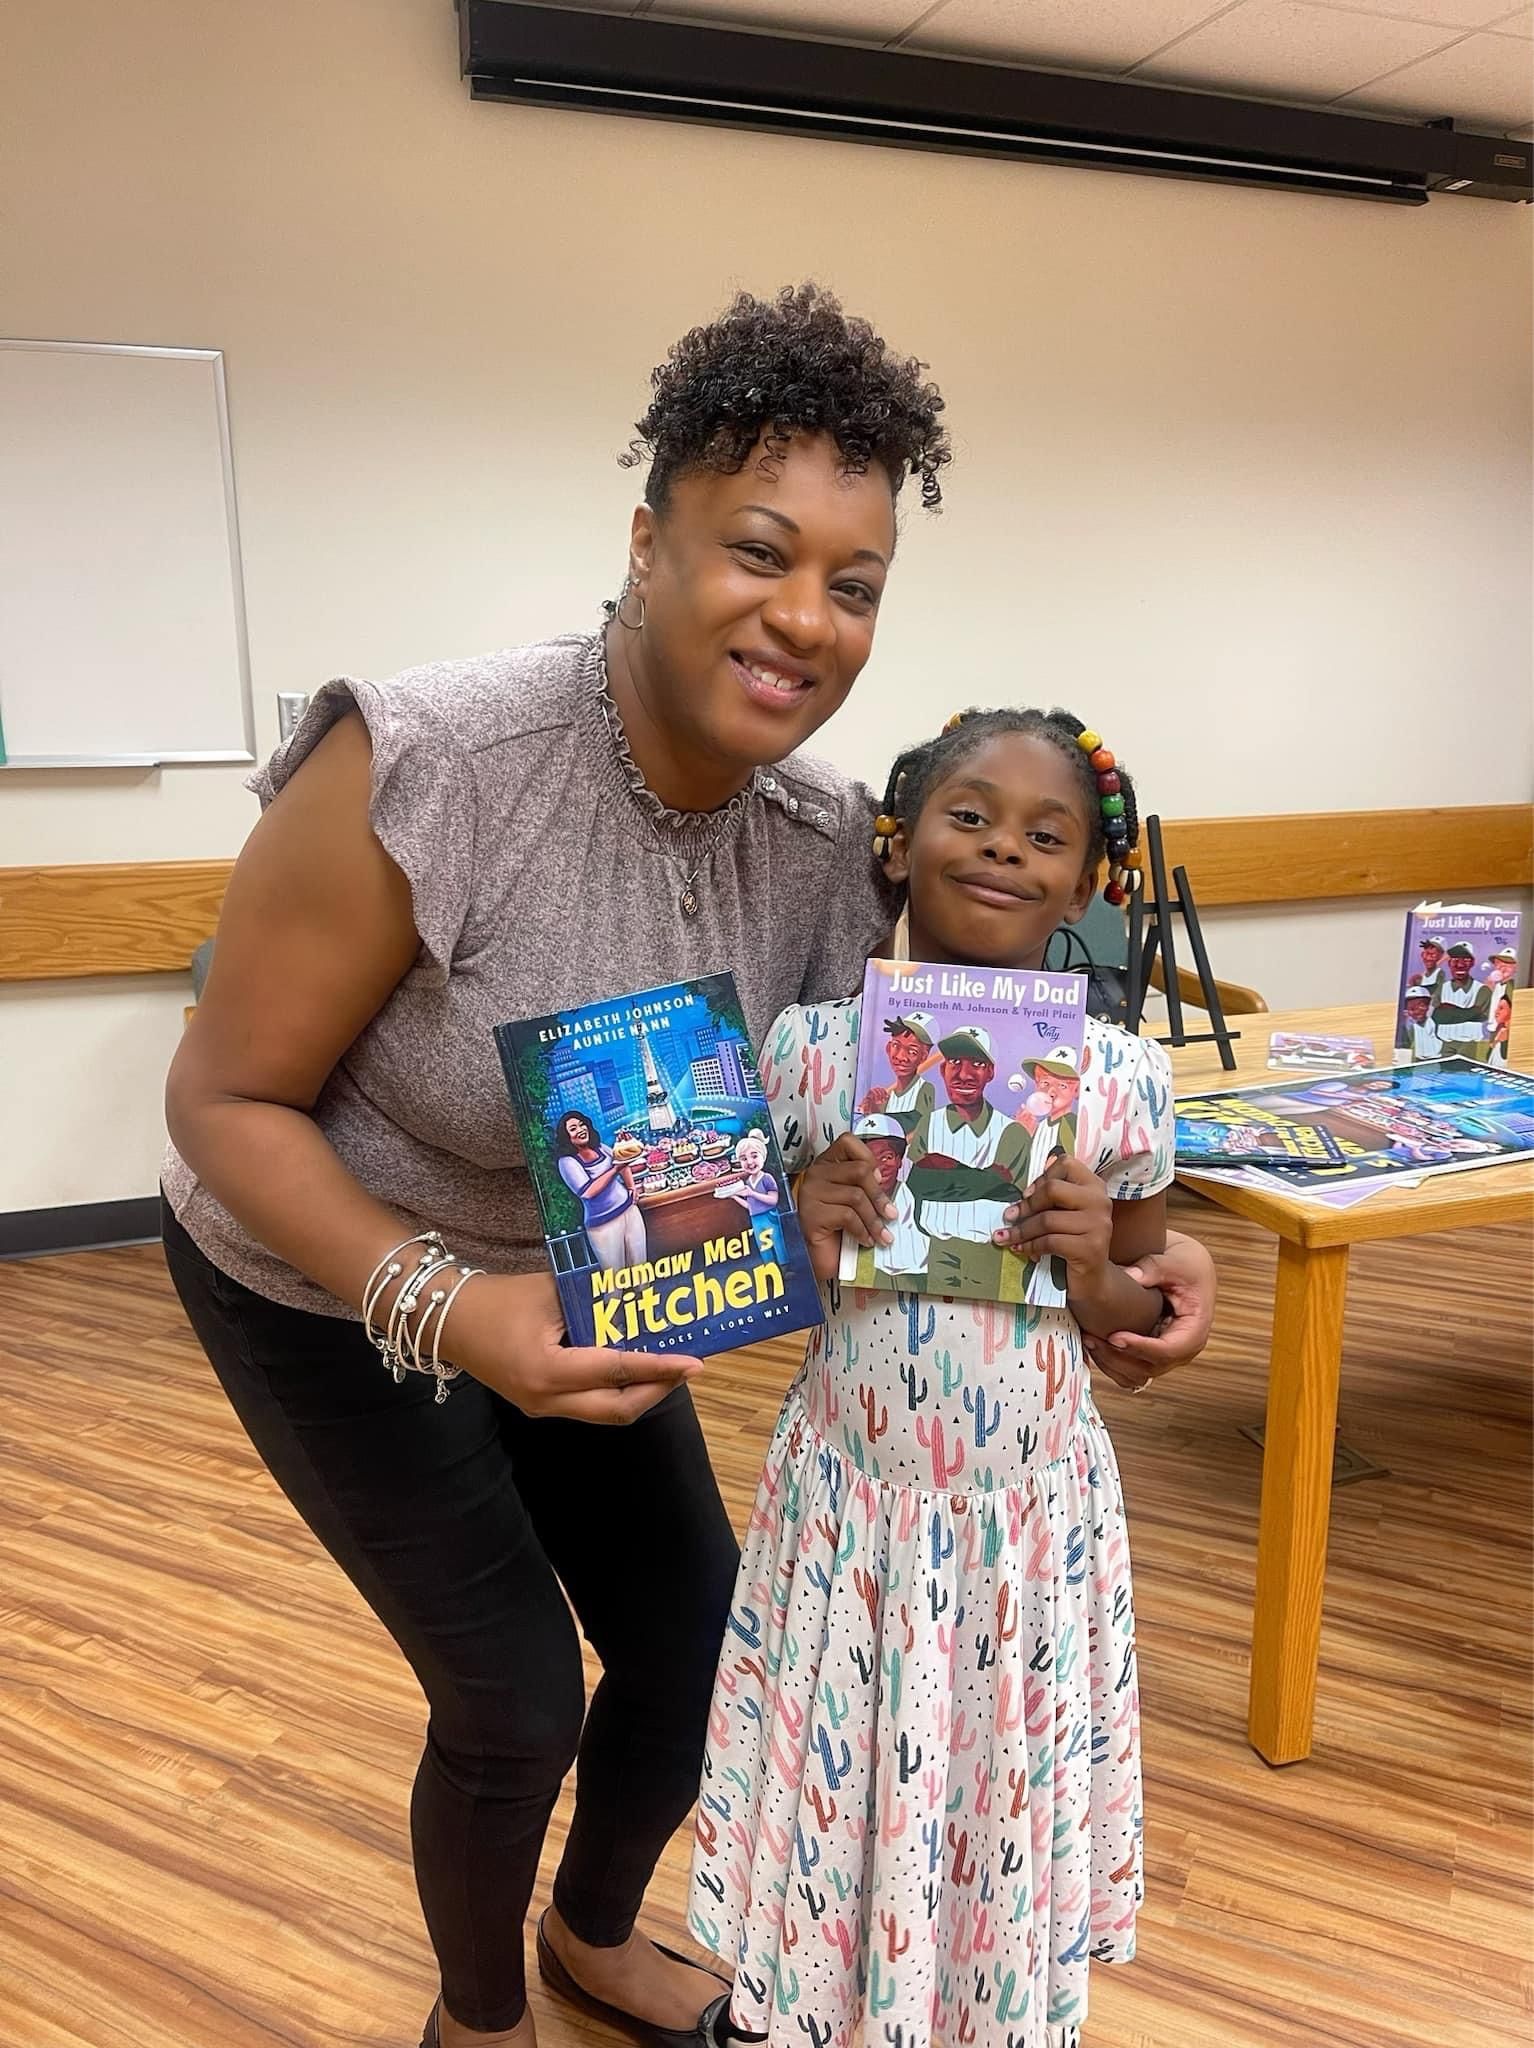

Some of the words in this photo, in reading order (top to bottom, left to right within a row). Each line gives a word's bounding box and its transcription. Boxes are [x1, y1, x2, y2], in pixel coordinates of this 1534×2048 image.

[1422, 916, 1446, 929] Just
[1448, 916, 1471, 929] Like
[1474, 916, 1491, 930] My
[1494, 916, 1518, 929] Dad
[888, 997, 901, 1007] By
[903, 999, 949, 1011] Elizabeth
[967, 1004, 1008, 1015] Johnson
[1012, 1007, 1020, 1016] &
[889, 969, 934, 995] Just
[941, 974, 985, 999] Like
[992, 976, 1027, 1007] My
[1033, 979, 1080, 1006] Dad
[539, 1011, 620, 1042] ELIZABETH
[626, 994, 694, 1021] JOHNSON
[573, 1027, 626, 1050] AUNTIE
[591, 1250, 693, 1298] Mamaw
[703, 1229, 775, 1267] Mel's
[593, 1261, 785, 1347] Kitchen
[659, 1333, 693, 1348] GOES
[703, 1327, 710, 1336] A
[720, 1315, 754, 1331] LONG
[764, 1305, 790, 1319] WAY
